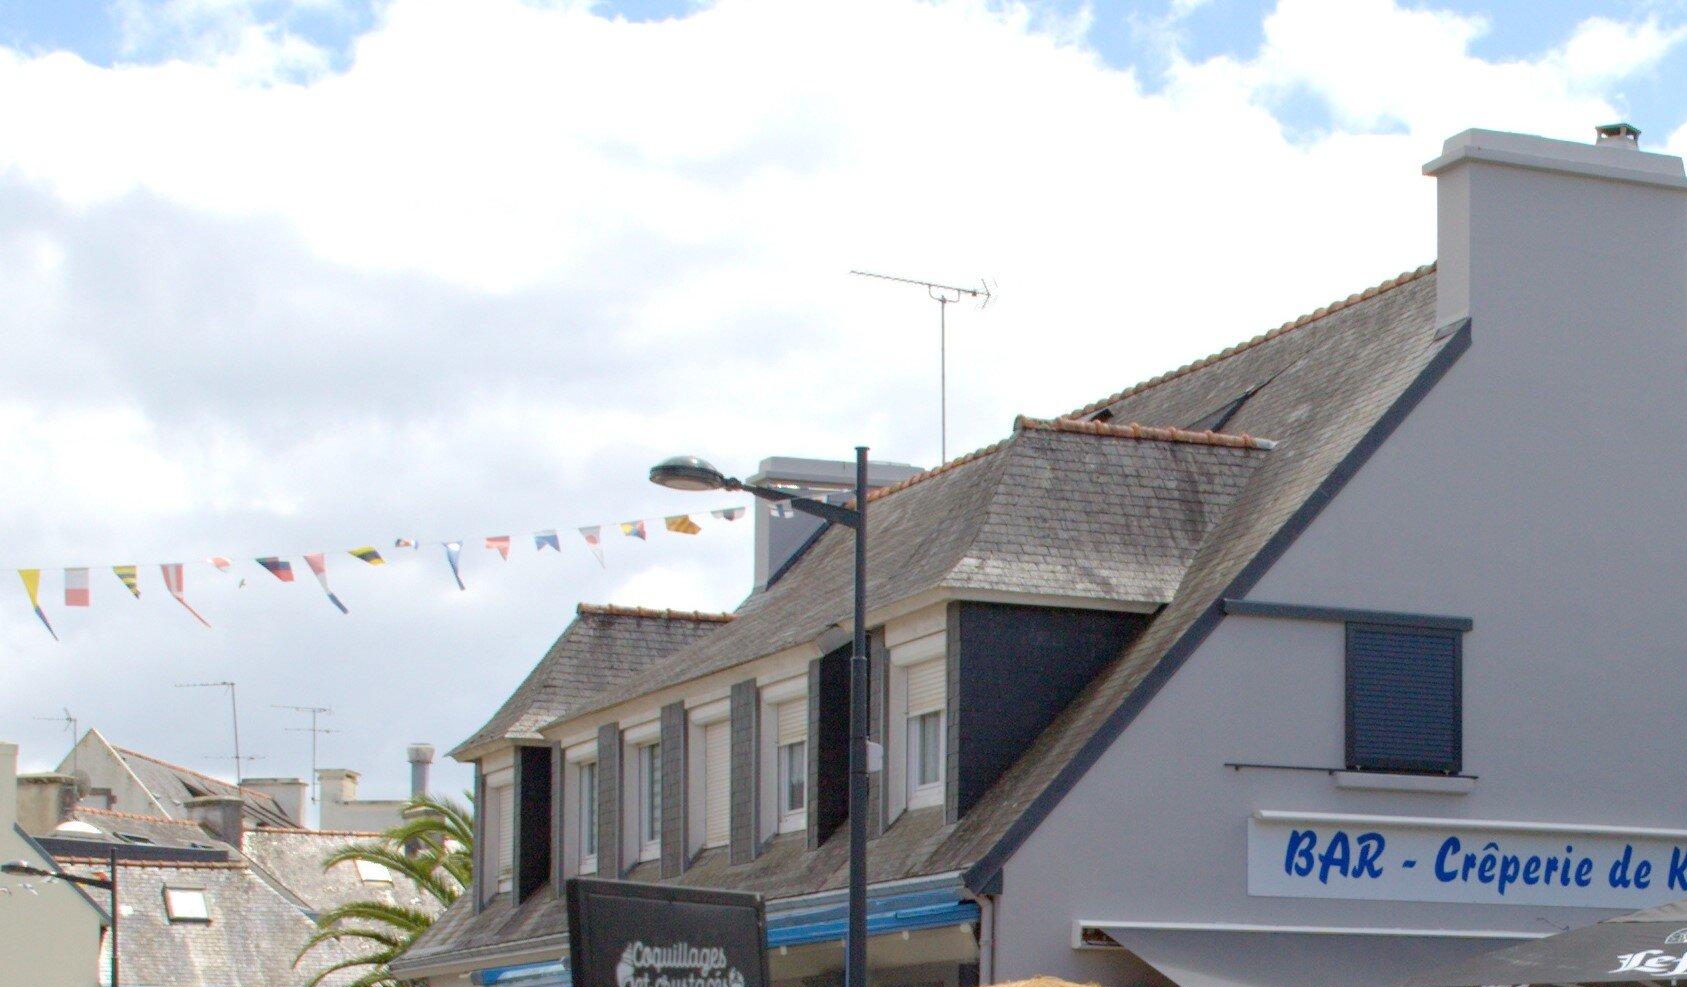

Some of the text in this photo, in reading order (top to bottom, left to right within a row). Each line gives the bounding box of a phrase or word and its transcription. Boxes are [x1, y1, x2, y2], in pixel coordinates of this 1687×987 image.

[1284, 829, 1386, 885] BAR
[1402, 859, 1417, 868] -
[1434, 836, 1594, 895] Crêperie
[1608, 844, 1652, 890] de
[632, 941, 727, 977] Coquillages
